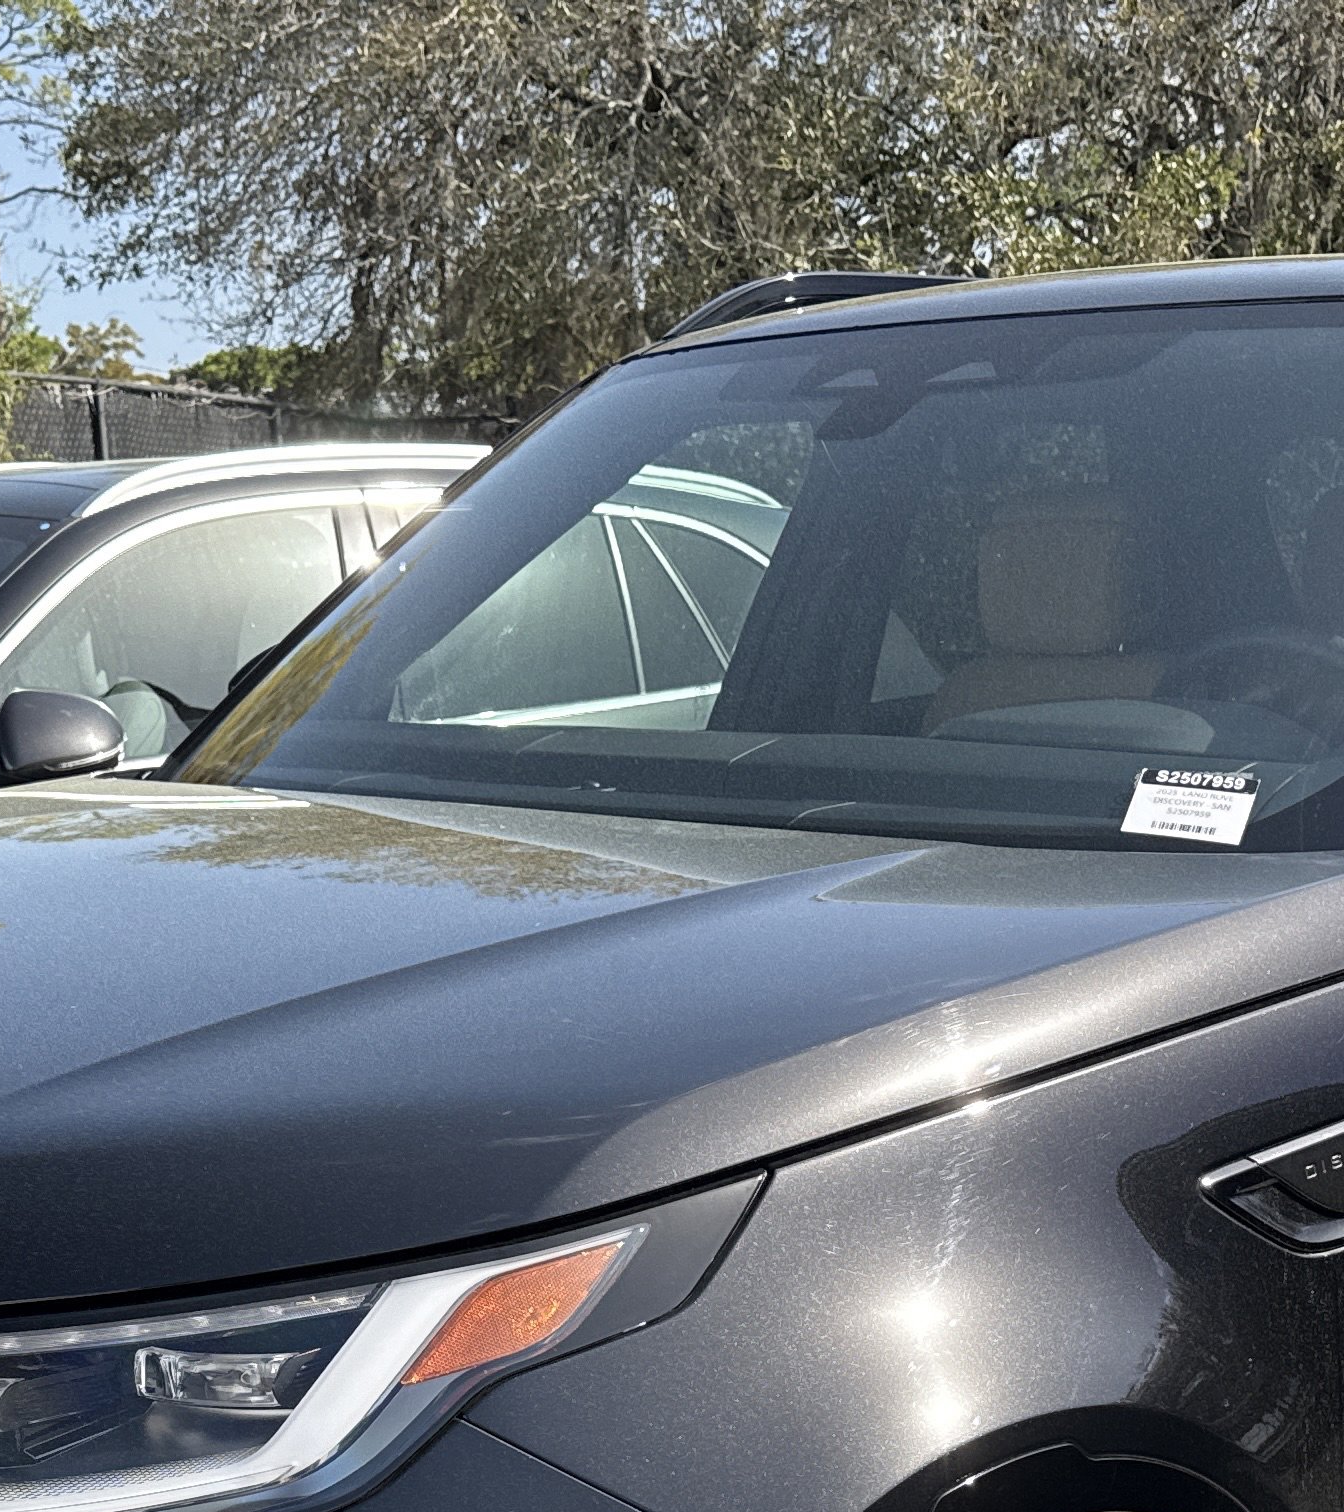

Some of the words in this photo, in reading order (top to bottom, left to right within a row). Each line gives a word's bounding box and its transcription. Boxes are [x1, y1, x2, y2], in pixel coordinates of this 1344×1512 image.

[1155, 769, 1246, 790] S2507959
[1182, 790, 1208, 799] LAND
[1153, 796, 1205, 808] DISCOVERY
[1212, 802, 1232, 812] SAN
[1166, 808, 1211, 818] S2507959
